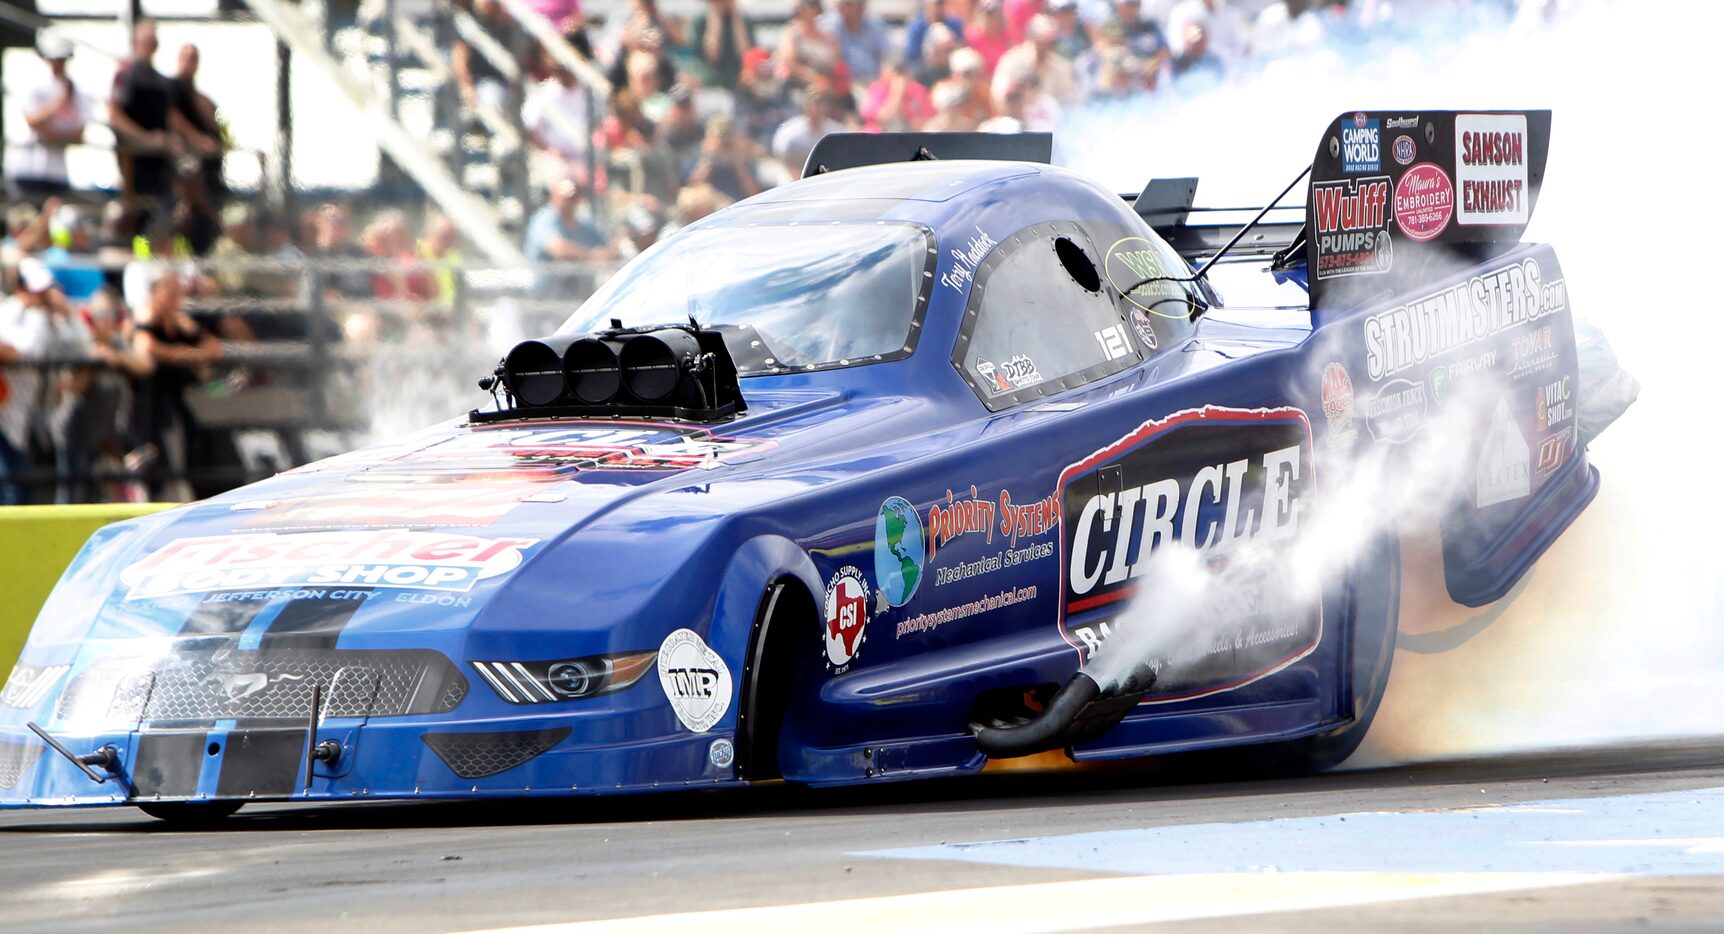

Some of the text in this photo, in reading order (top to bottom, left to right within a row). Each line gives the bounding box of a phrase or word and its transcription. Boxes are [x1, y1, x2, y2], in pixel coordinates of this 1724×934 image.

[1343, 128, 1378, 144] CAMPING
[1396, 141, 1413, 159] NHRA
[1462, 131, 1522, 166] SAMSON
[1344, 144, 1379, 162] WORLD
[1405, 171, 1441, 195] Maura's
[1463, 179, 1522, 213] EXHAUST
[1315, 182, 1387, 232] Wulff
[1397, 188, 1450, 211] EMBROIDERY
[1321, 231, 1374, 254] PUMPS
[1095, 324, 1134, 361] 121
[1511, 326, 1552, 360] TOVAR
[1448, 351, 1497, 380] FAIRWAY
[1478, 463, 1529, 489] VERTEX
[1070, 445, 1301, 595] CIRCLE
[137, 530, 531, 570] Fischer
[935, 542, 1054, 586] Mechanical Services
[141, 565, 469, 595] BODY SHOP
[202, 590, 326, 604] JEFFERSON
[329, 589, 381, 601] CITY
[394, 592, 472, 608] ELDON
[896, 584, 1037, 640] prioritysystemsmechanical.com
[840, 601, 858, 630] CSI
[667, 667, 719, 700] IMP
